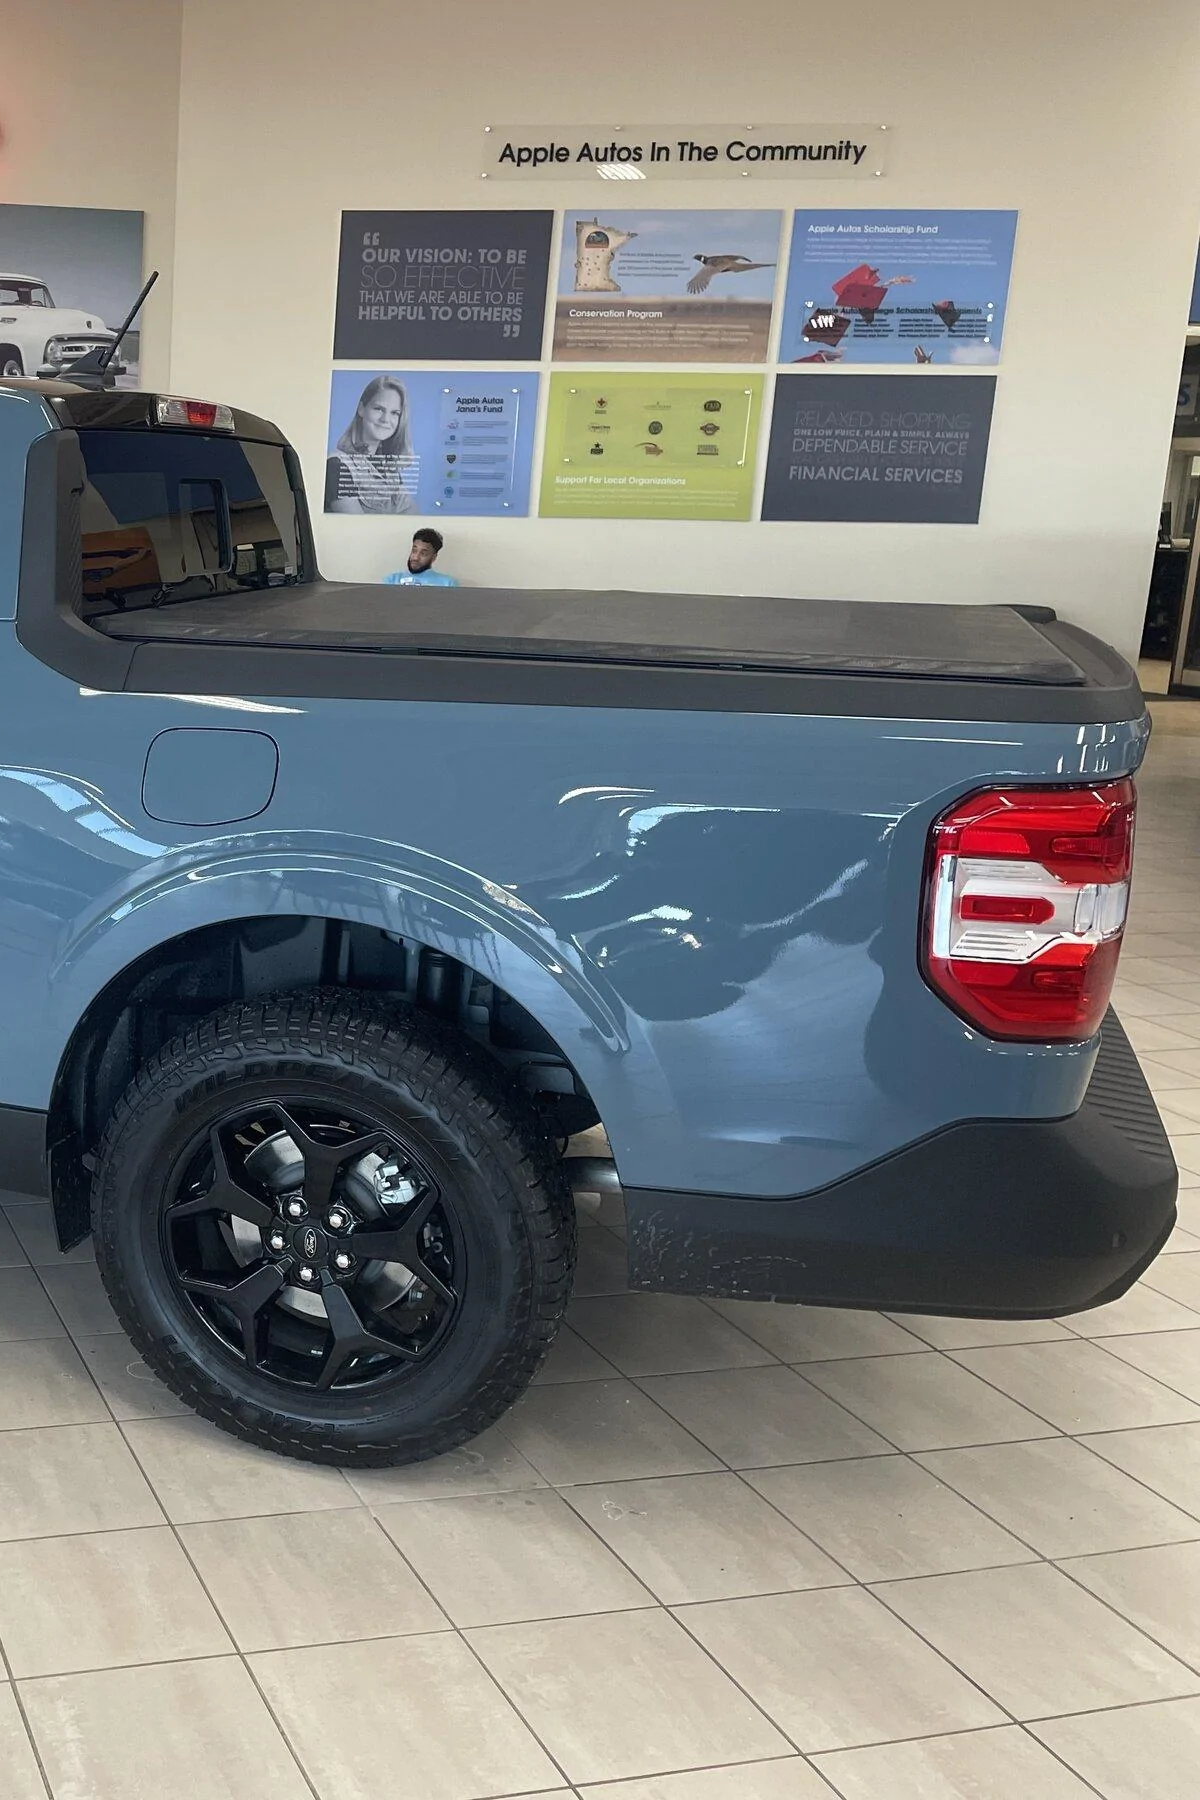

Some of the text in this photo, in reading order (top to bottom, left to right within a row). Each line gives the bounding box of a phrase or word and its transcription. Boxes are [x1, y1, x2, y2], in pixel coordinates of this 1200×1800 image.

[499, 140, 867, 167] Apple Autos In The Community
[807, 225, 939, 235] Apple Autos Scholarship Fund
[362, 248, 528, 265] OUR VISION: TO BE
[360, 265, 526, 290] SO EFFECTIVE
[359, 290, 524, 306] THAT WE ARE ABLE TO BE
[358, 306, 523, 322] HELPFUL TO OTHERS
[569, 309, 663, 320] Conservation Program
[456, 396, 480, 405] Apple
[456, 405, 482, 413] Jana's
[795, 410, 972, 429] RELAXED SHOPPING
[792, 438, 968, 456] DEPENDABLE SERVICE
[555, 476, 686, 486] Support For Local Organizations
[789, 466, 963, 484] FINANCIAL SERVICES
